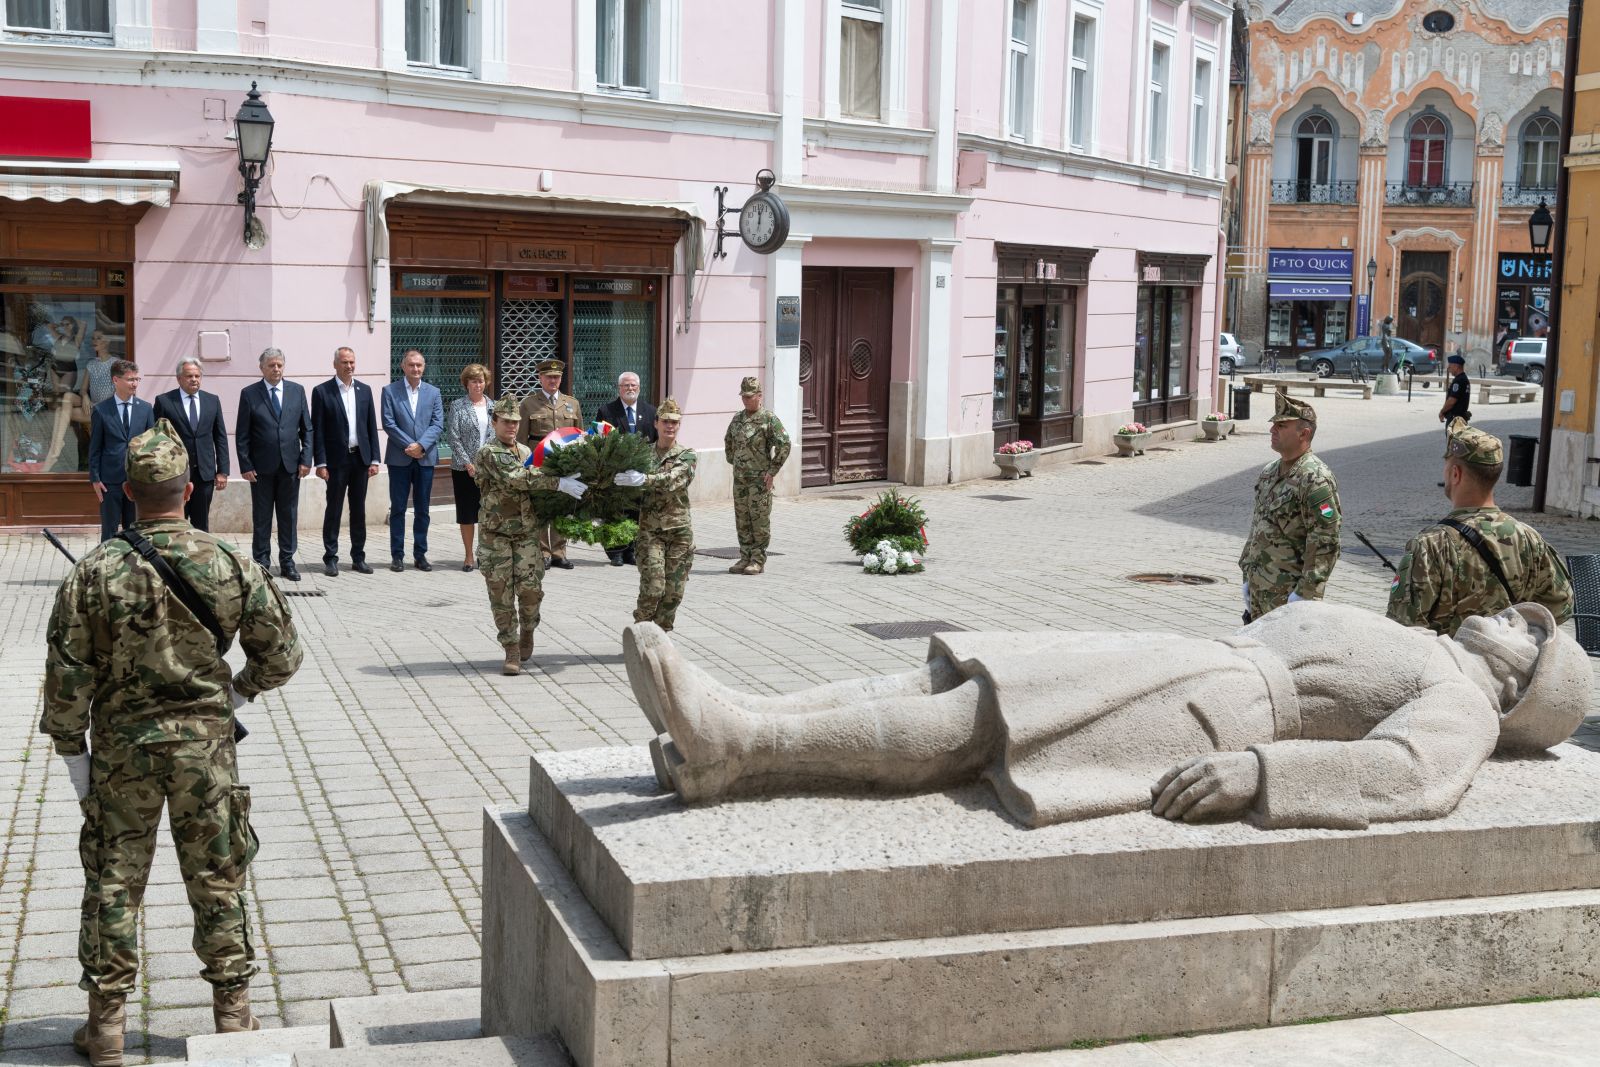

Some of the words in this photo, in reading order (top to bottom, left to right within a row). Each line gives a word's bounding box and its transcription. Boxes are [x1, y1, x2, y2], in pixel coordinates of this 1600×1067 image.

[1308, 257, 1348, 271] QUICK
[412, 278, 443, 286] TISSOT
[596, 282, 633, 291] LONGINES
